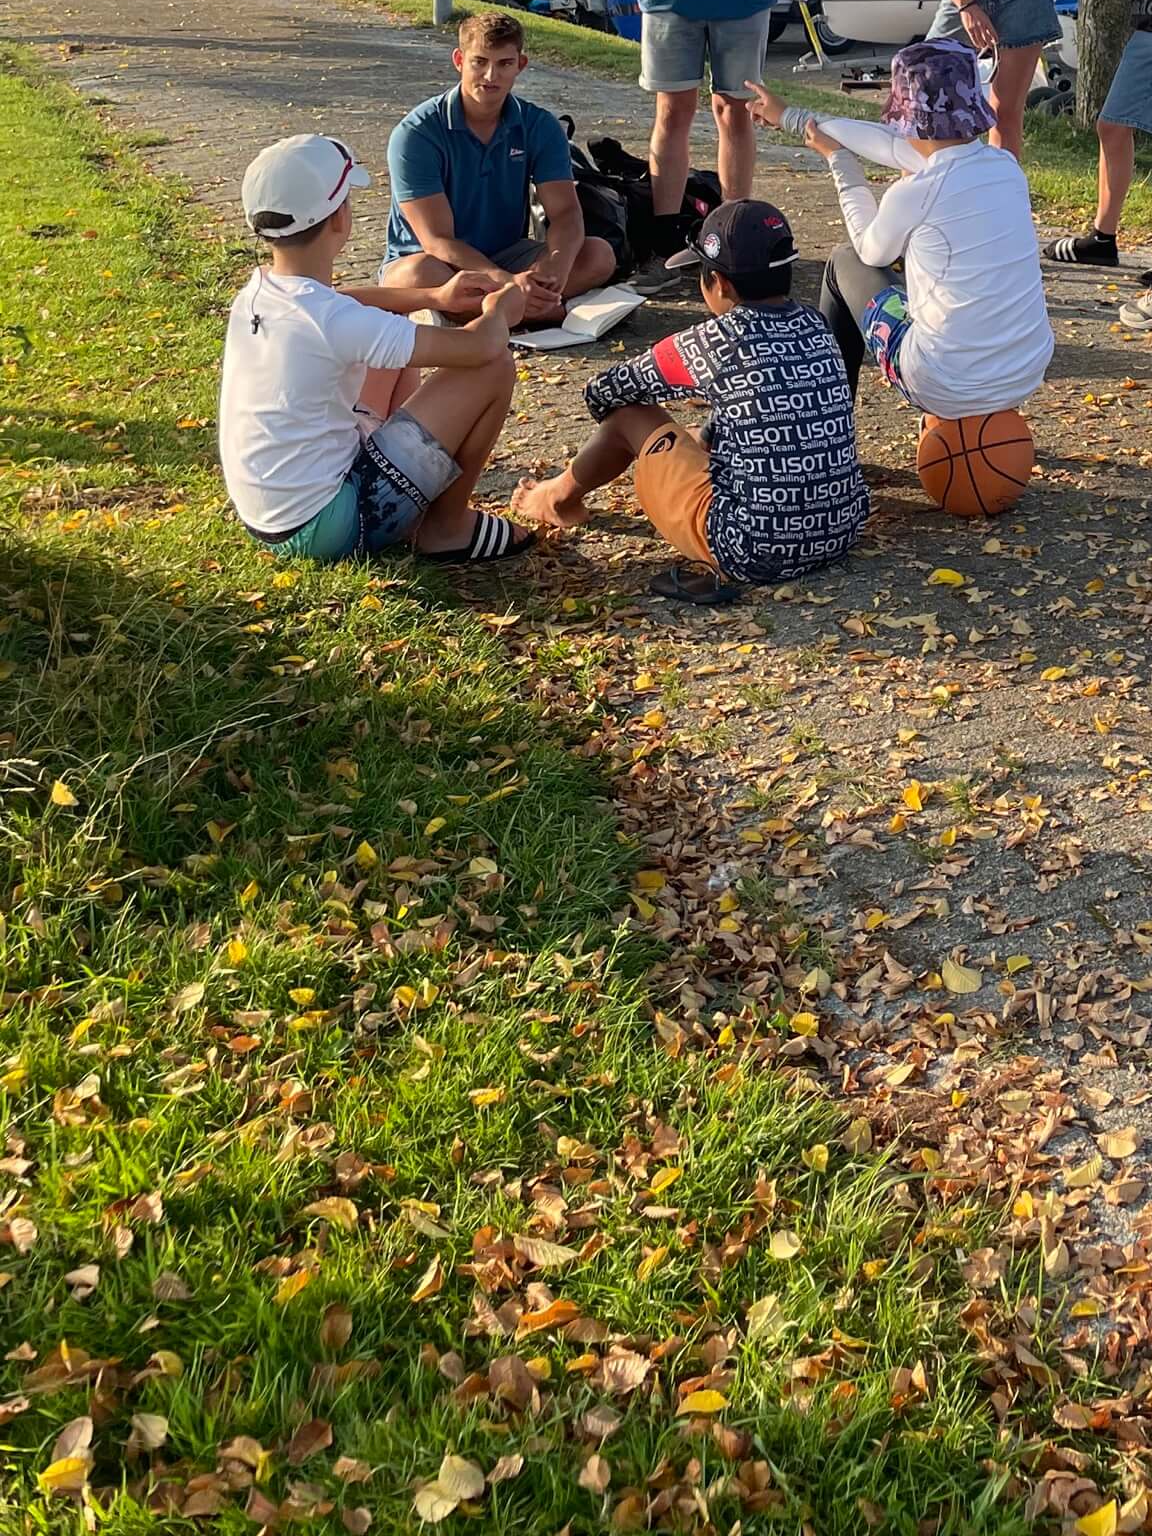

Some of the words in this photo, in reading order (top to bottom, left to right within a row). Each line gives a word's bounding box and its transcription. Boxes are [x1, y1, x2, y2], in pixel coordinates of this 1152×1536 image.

[738, 341, 796, 360] LISOT
[742, 356, 779, 369] Sailing
[781, 353, 803, 363] Team
[713, 367, 777, 395] LISOT
[780, 359, 834, 381] LISOT
[721, 388, 755, 402] Sailing
[755, 383, 783, 394] Team
[786, 378, 817, 390] Sailing
[818, 374, 838, 385] Team
[756, 392, 814, 414] LISOT
[817, 384, 851, 404] LISO
[733, 418, 758, 427] Team
[761, 413, 796, 423] Sailing
[798, 409, 819, 418] Team
[735, 426, 793, 447] LISOT
[796, 415, 848, 441] LISOT
[740, 445, 770, 455] Sailing
[772, 444, 797, 453] Team
[800, 438, 829, 450] Sailing
[829, 434, 848, 446] Team
[769, 453, 826, 474] LISOT
[828, 445, 856, 463] LISO
[772, 474, 806, 484] Sailing
[807, 471, 827, 481] Team
[804, 479, 849, 501] LISOT
[750, 503, 775, 513] ailing
[776, 503, 801, 512] Team
[804, 498, 831, 510] Sailing
[772, 513, 828, 532] LISOT
[773, 530, 804, 540] Sailing
[805, 528, 825, 538] Team
[800, 534, 848, 556] LISOT
